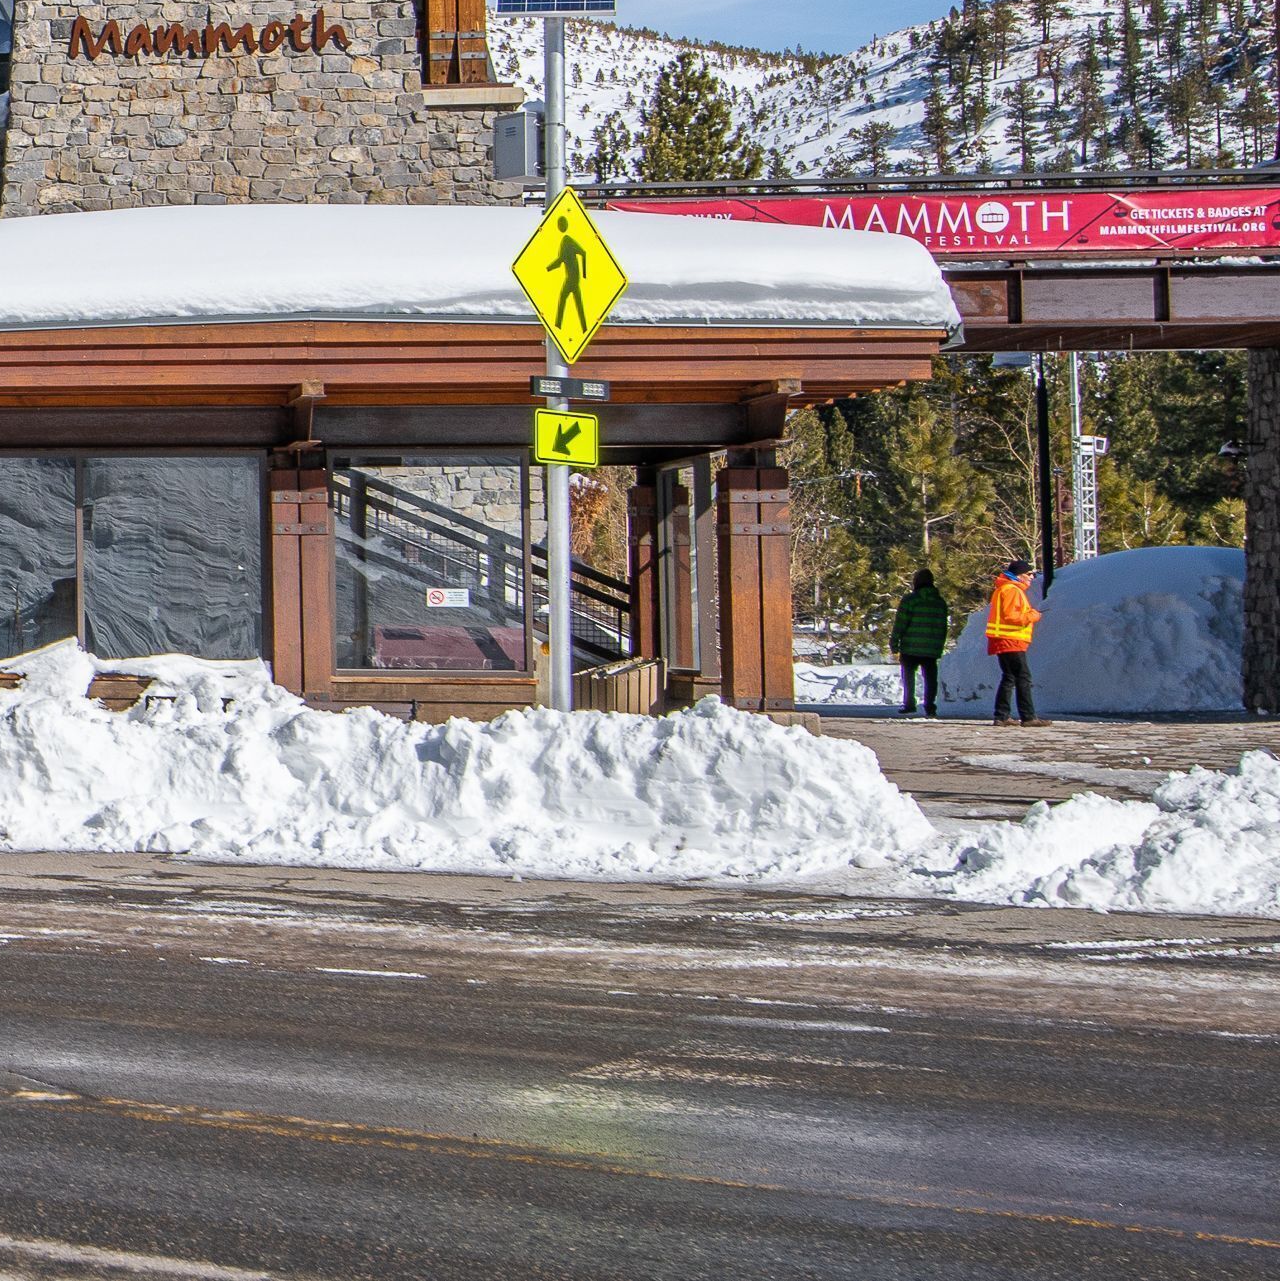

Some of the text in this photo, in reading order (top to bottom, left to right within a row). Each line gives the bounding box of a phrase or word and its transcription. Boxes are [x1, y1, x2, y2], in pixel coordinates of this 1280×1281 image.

[69, 7, 352, 60] Mammoth
[822, 201, 1070, 233] MAMMOTH
[1130, 206, 1267, 220] GET TICKETS & BADGES AT
[1100, 222, 1266, 235] MAMMOTHFILMFESTIVAL.ORG
[925, 235, 1032, 246] FESTIVAL
